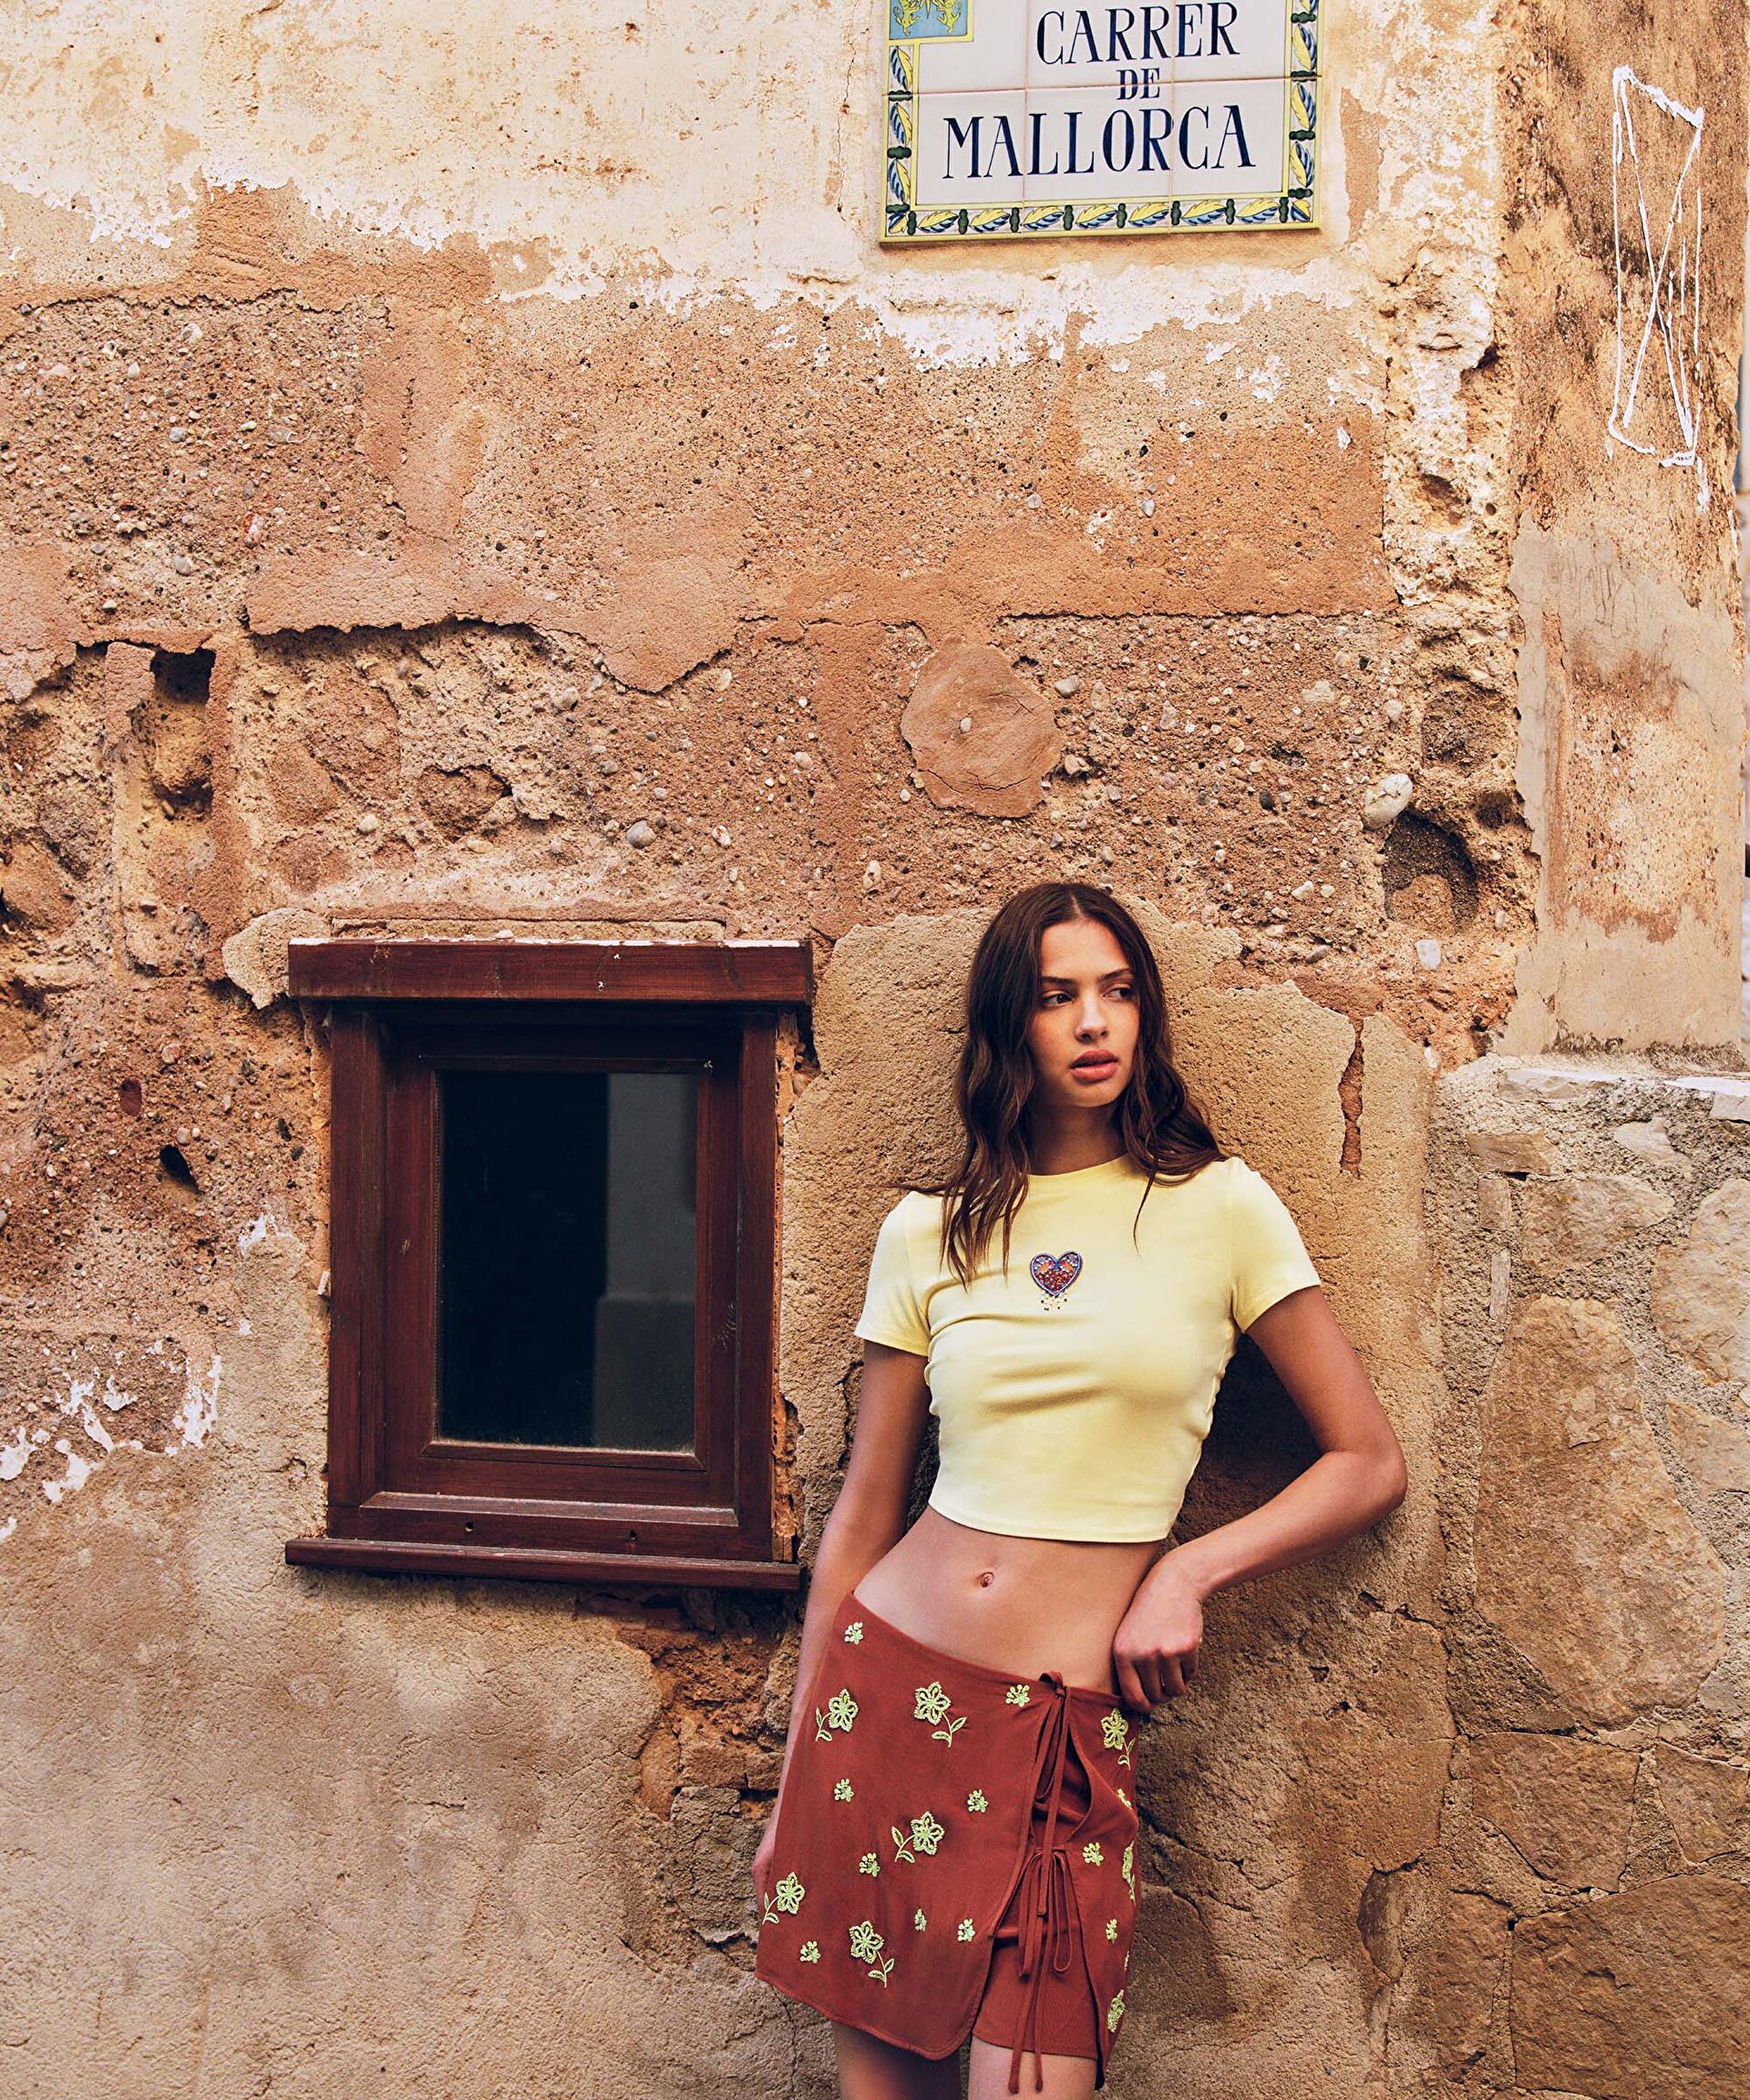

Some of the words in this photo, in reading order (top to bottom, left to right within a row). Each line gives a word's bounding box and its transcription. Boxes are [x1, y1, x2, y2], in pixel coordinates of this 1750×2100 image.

[1036, 2, 1240, 65] CARRER
[1117, 67, 1161, 101] DE
[942, 105, 1257, 180] MALLORCA
